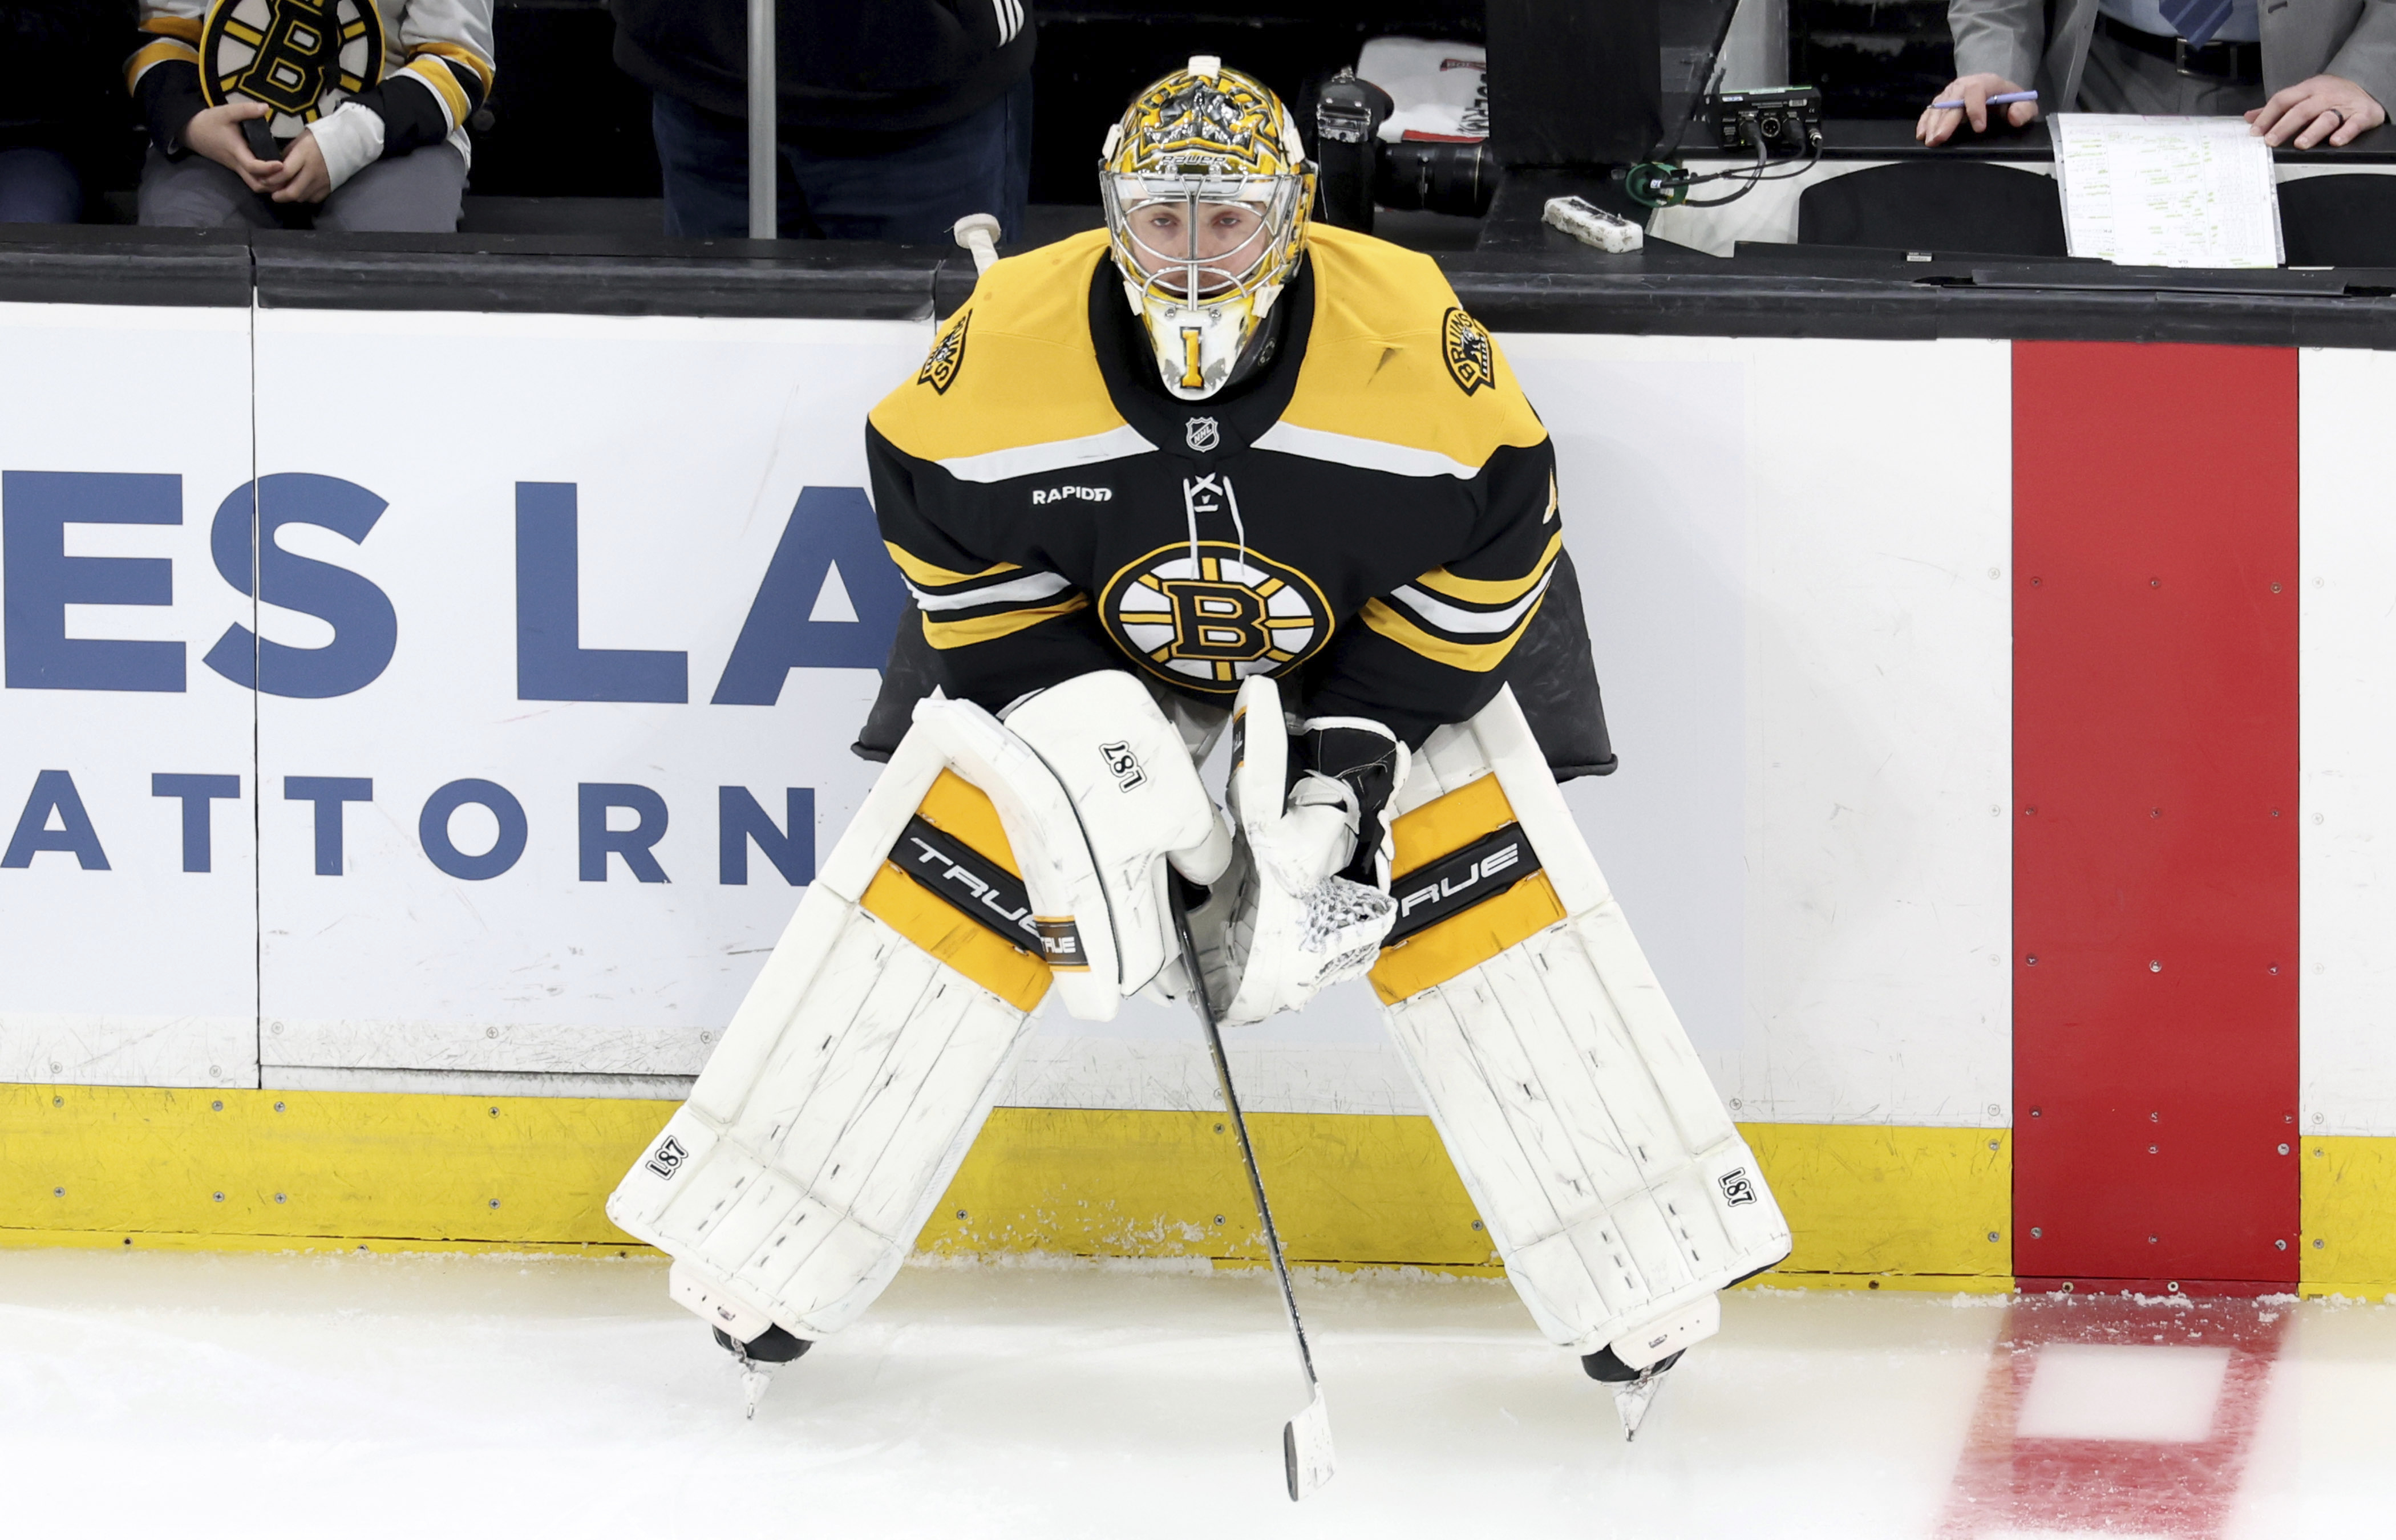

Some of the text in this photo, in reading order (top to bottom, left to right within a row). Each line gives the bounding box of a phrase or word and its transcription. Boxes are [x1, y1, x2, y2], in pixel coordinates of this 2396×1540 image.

[1193, 425, 1212, 444] NHL
[1033, 486, 1112, 505] RAPID7
[2, 470, 910, 706] ES LA
[1161, 581, 1272, 661] B
[1102, 744, 1143, 789] L87
[1401, 842, 1519, 918] RUE
[649, 1138, 685, 1177] L87
[1722, 1170, 1753, 1205] L87
